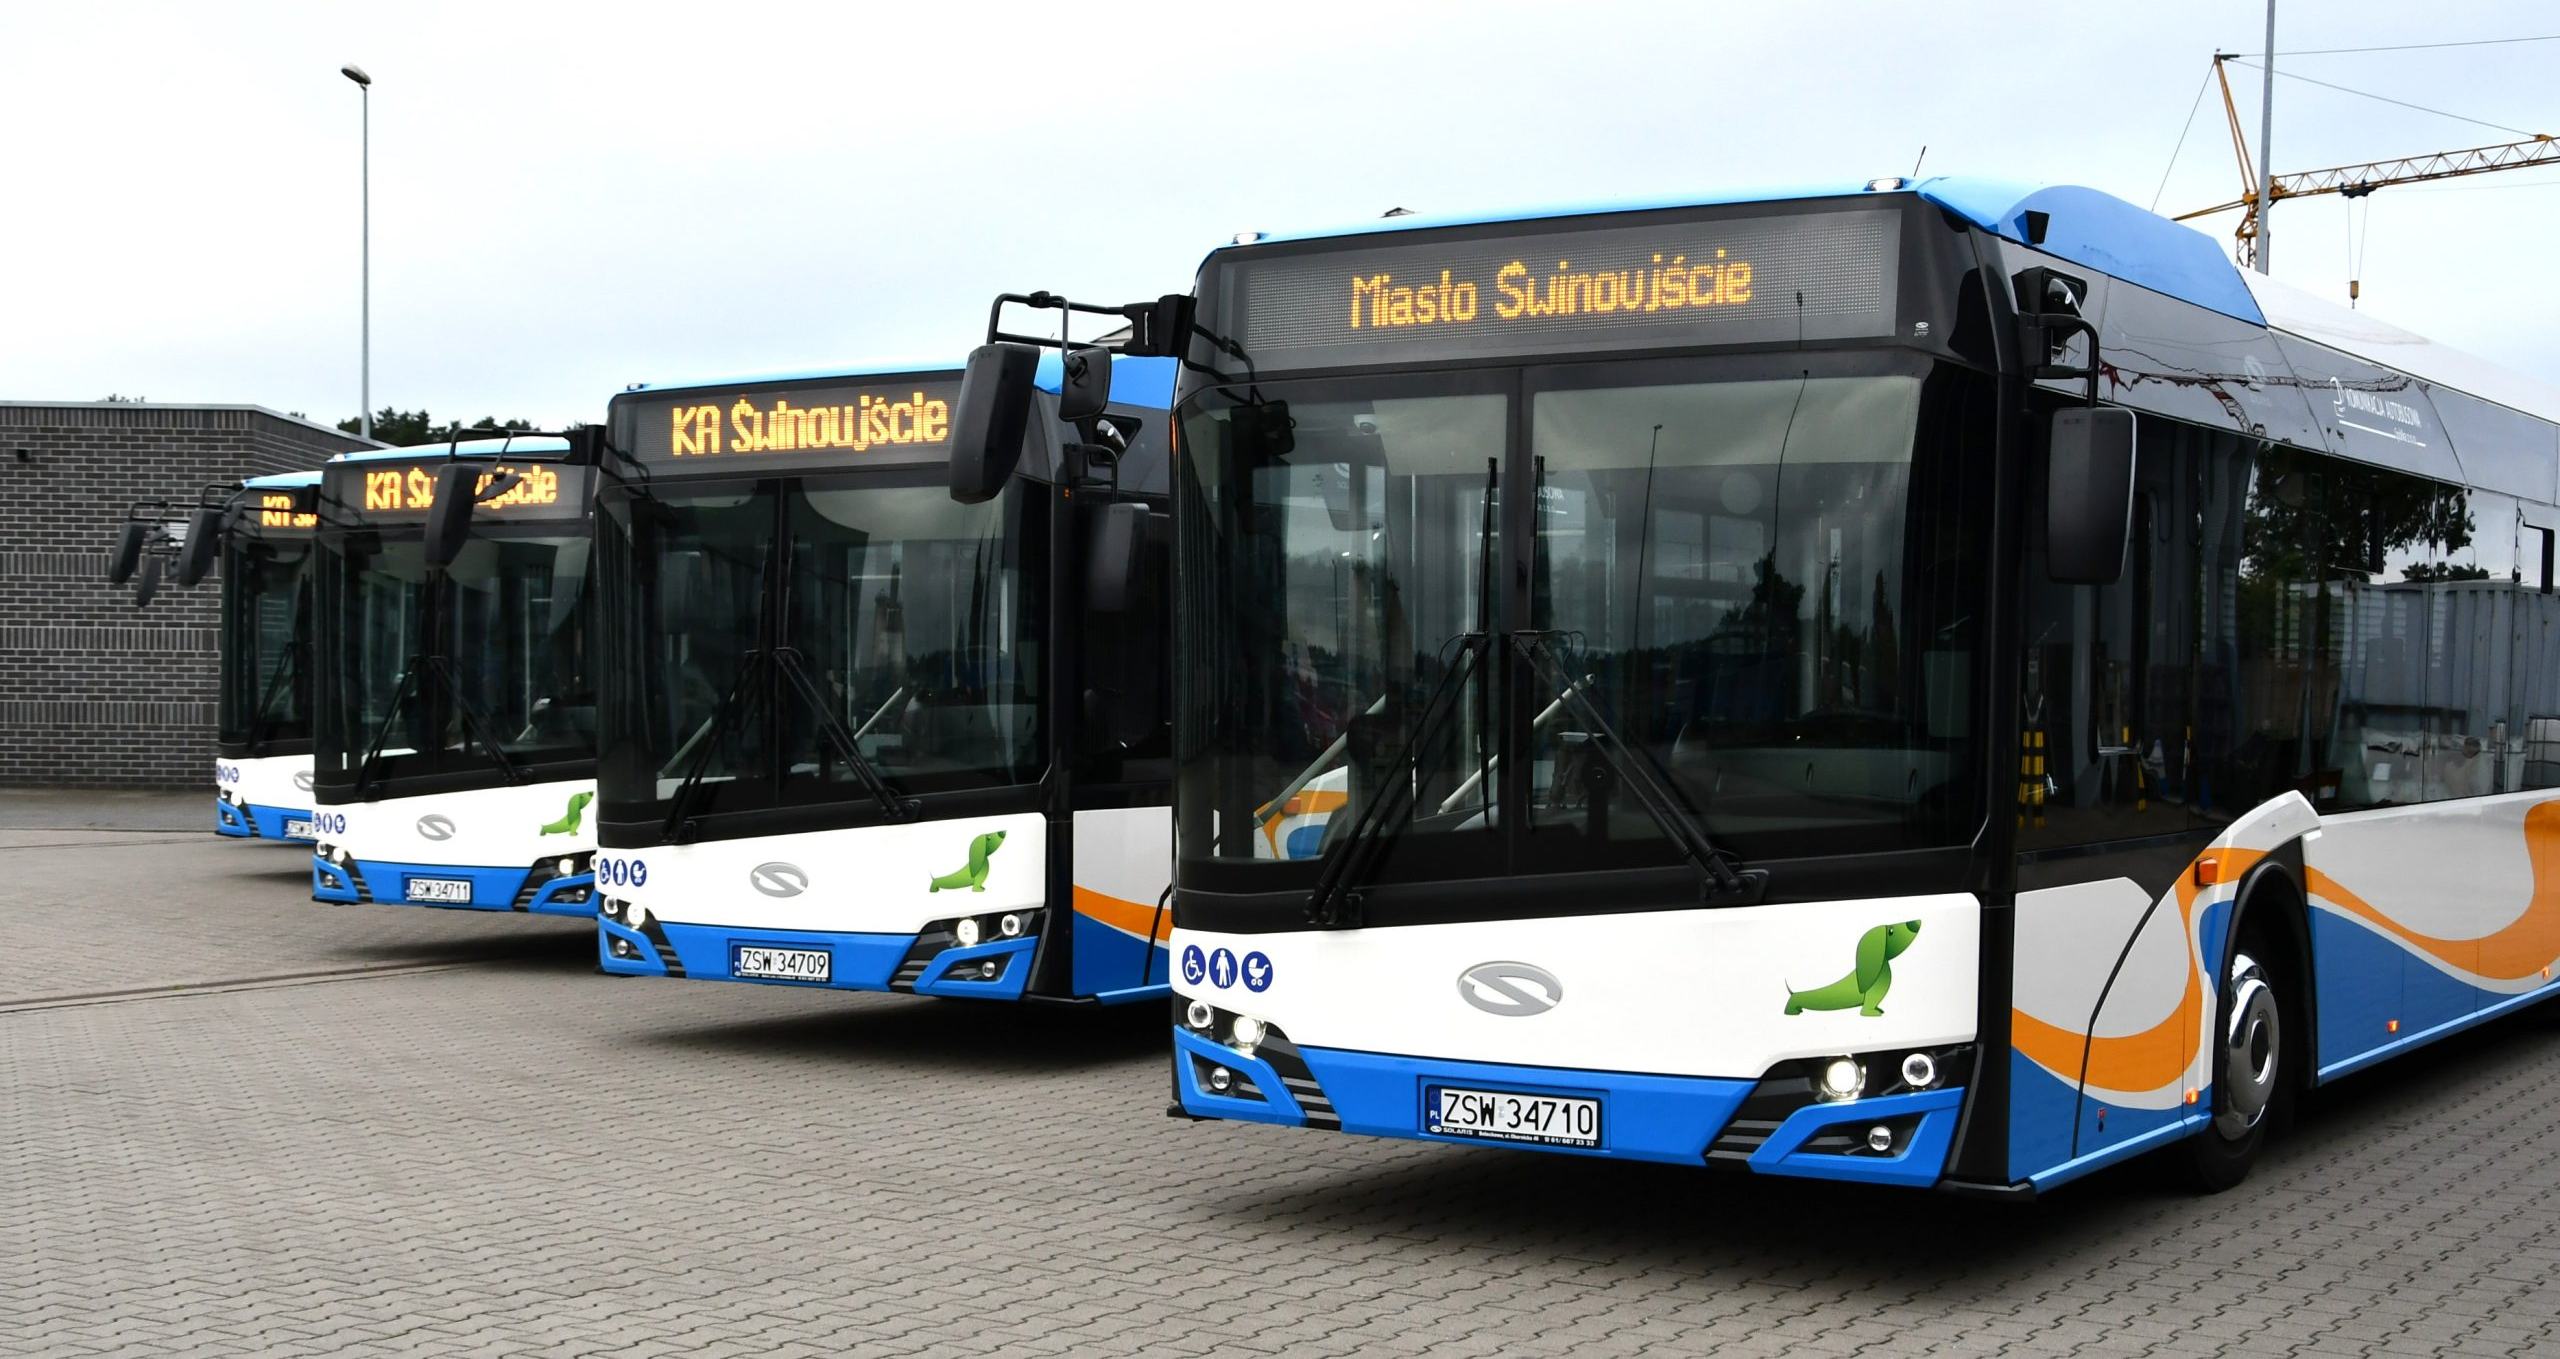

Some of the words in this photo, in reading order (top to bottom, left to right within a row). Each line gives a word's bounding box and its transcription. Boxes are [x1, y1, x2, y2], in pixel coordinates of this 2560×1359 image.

[1351, 270, 1477, 328] Miasto
[1495, 249, 1752, 318] Świnoujście
[672, 405, 721, 456] KA
[731, 391, 948, 451] Świnoujście
[366, 471, 402, 509] KA
[411, 881, 431, 897] ZSW
[435, 882, 468, 899] 34711
[742, 950, 772, 971] ZSW
[778, 952, 827, 975] 34709
[1430, 1110, 1440, 1120] PL
[1444, 1092, 1495, 1127] ZSW
[1507, 1098, 1593, 1135] 34710
[1443, 1127, 1473, 1136] SOLARIS
